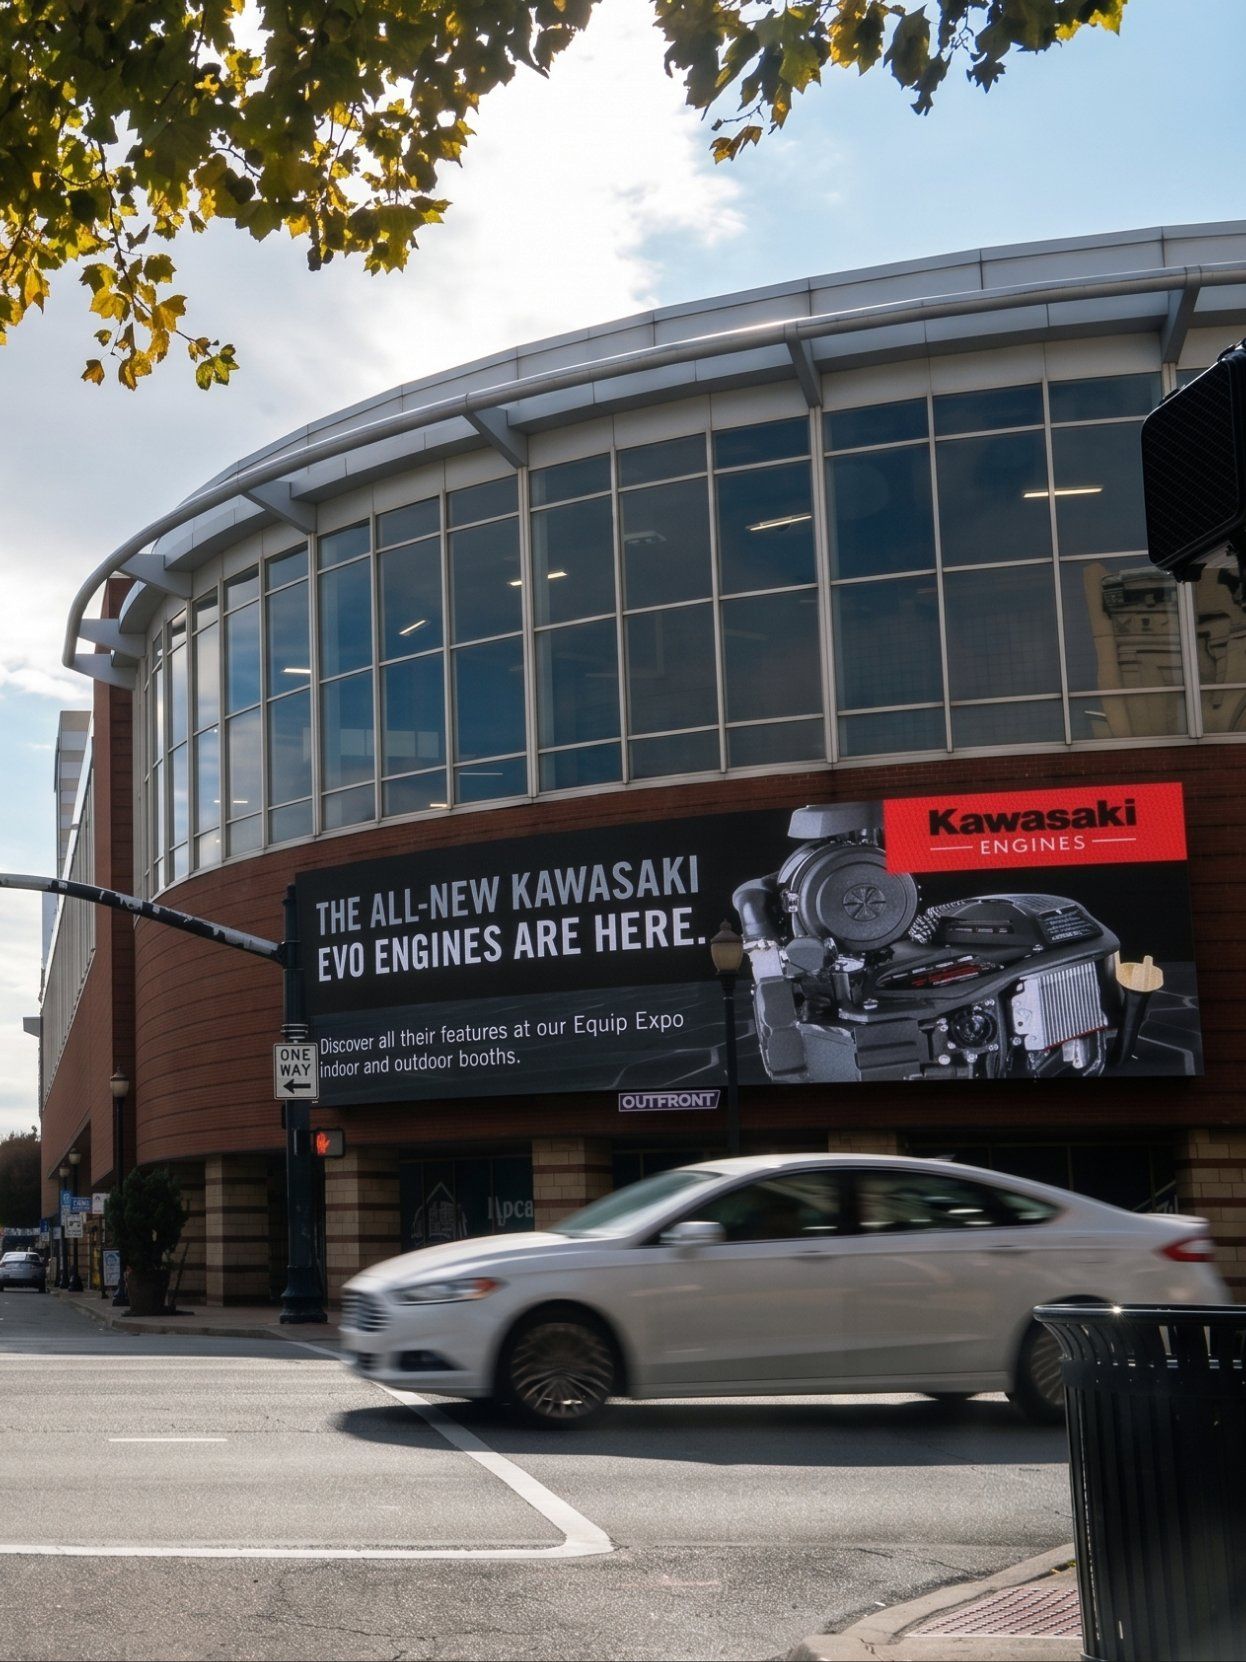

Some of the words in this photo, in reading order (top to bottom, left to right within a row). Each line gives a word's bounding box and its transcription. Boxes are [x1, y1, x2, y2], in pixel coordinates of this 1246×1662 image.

[928, 798, 1137, 836] Kawasaki
[980, 835, 1086, 855] ENGINES
[316, 896, 361, 936] THE
[370, 876, 500, 929] ALL-NEW
[511, 855, 699, 911] KAWASAKI
[318, 942, 364, 982] EVO
[375, 925, 502, 974] ENGINES
[513, 917, 581, 960] ARE
[595, 906, 706, 953] HERE.
[320, 1037, 374, 1055] Discover
[378, 1030, 395, 1049] all
[400, 1028, 436, 1047] their
[440, 1024, 508, 1043] features
[513, 1020, 531, 1038] at
[536, 1021, 567, 1036] our
[574, 1013, 628, 1037] Equip
[636, 1011, 684, 1033] Expo
[280, 1048, 311, 1061] ONE
[280, 1063, 311, 1076] WAY
[320, 1060, 360, 1078] indoor
[363, 1055, 389, 1074] and
[394, 1052, 453, 1072] outdoor
[459, 1047, 521, 1068] booths.
[622, 1092, 715, 1109] OUTFRONT
